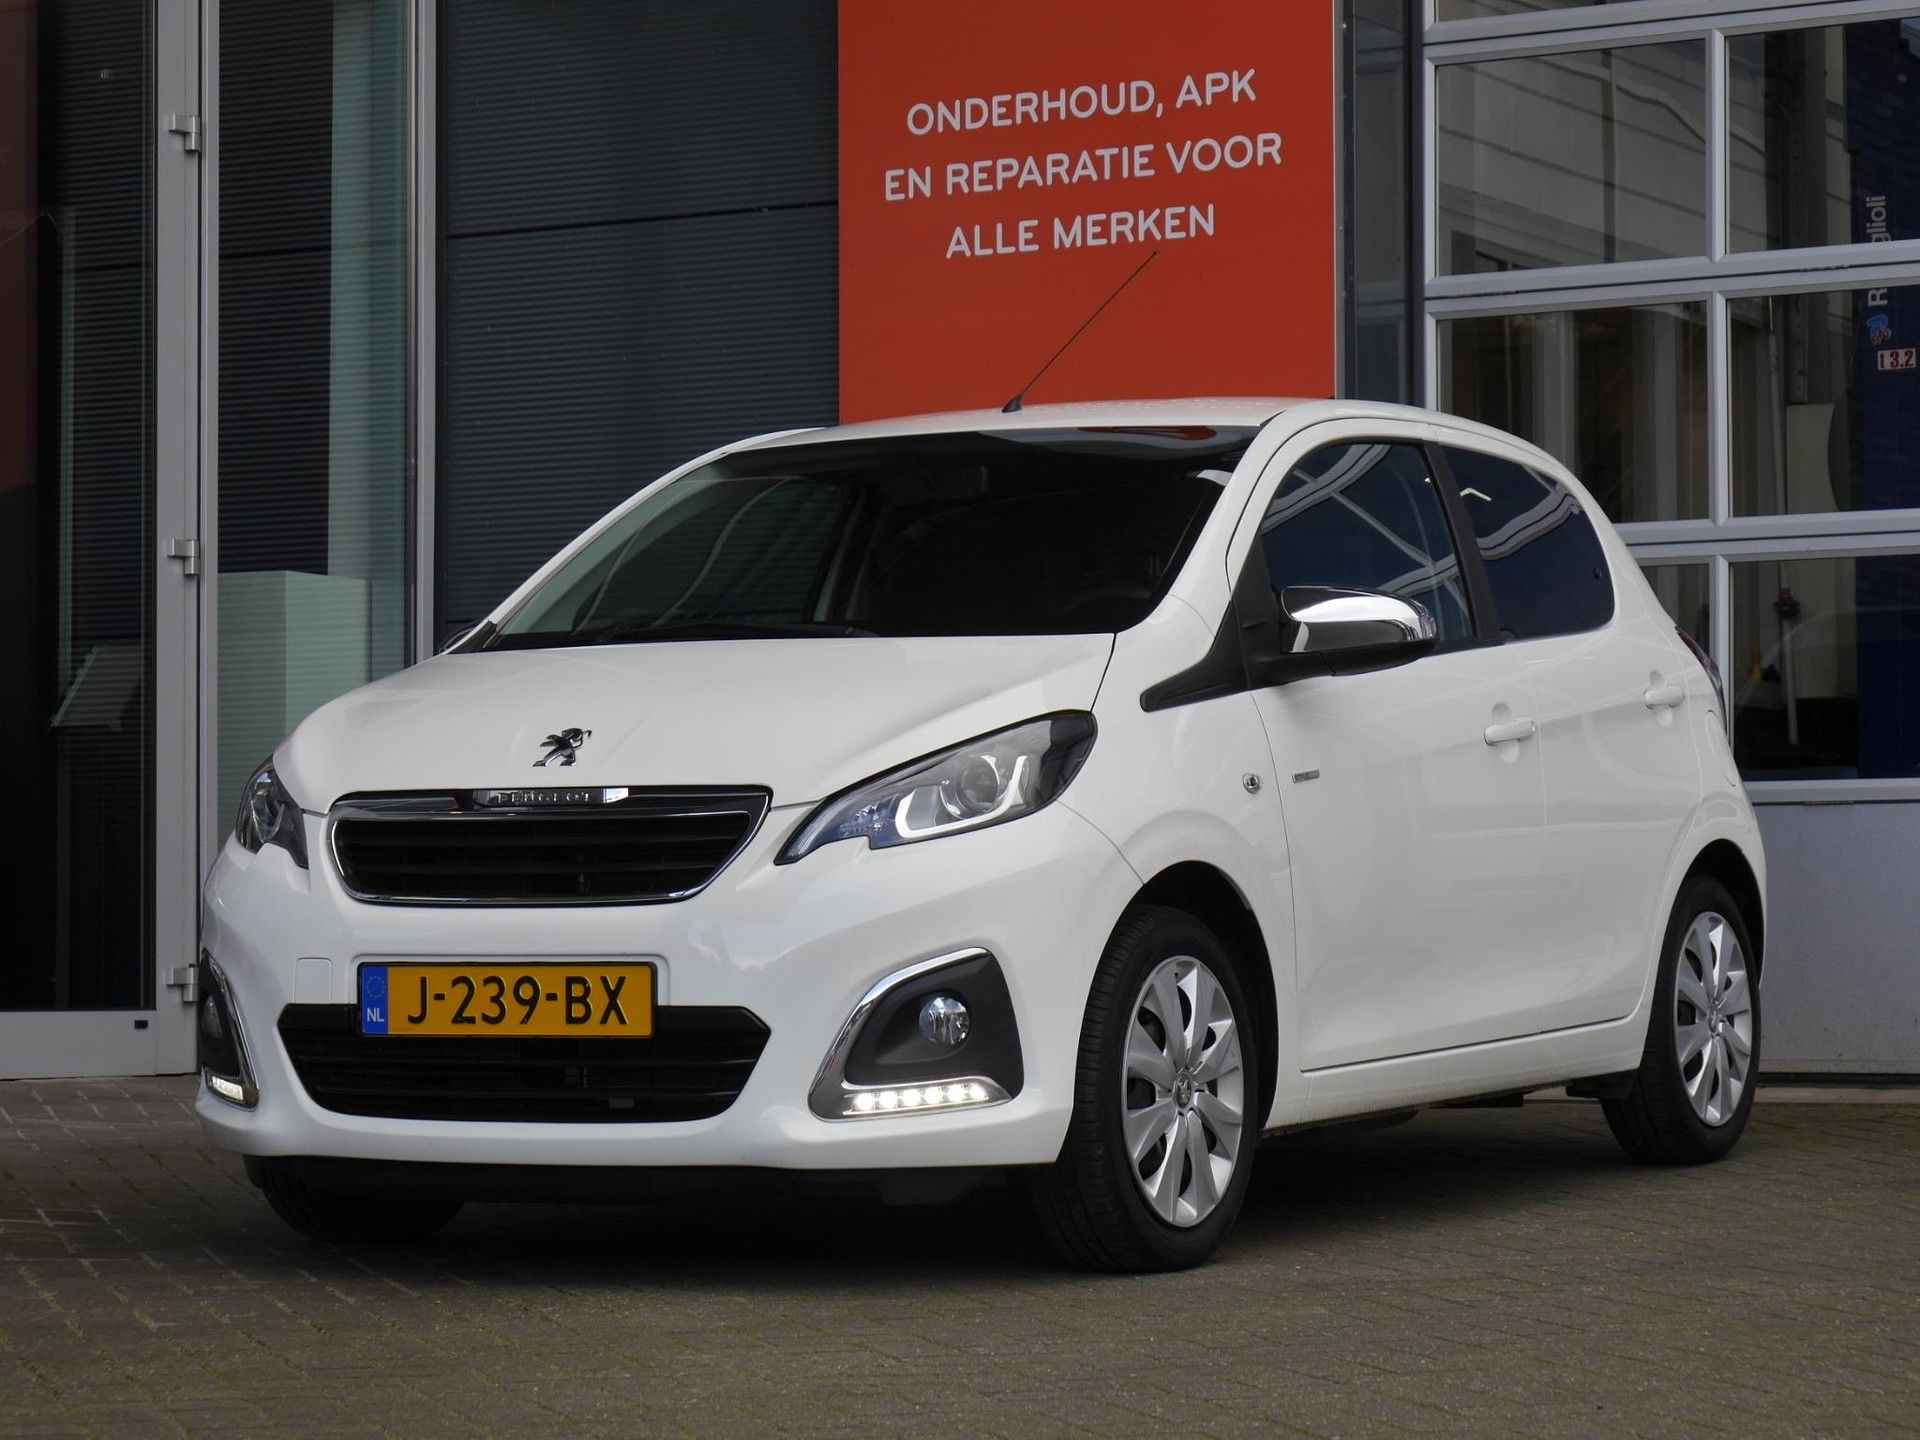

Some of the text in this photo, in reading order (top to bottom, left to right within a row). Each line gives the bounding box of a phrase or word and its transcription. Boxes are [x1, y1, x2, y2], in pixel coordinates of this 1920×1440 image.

[907, 69, 1256, 135] ONDERHOUD, APK
[886, 133, 1281, 200] EN REPARATIE VOOR
[946, 204, 1214, 259] ALLE MERKEN
[1889, 350, 1914, 368] 3.2
[368, 1008, 384, 1021] NL
[408, 976, 627, 1025] J-239-BX
